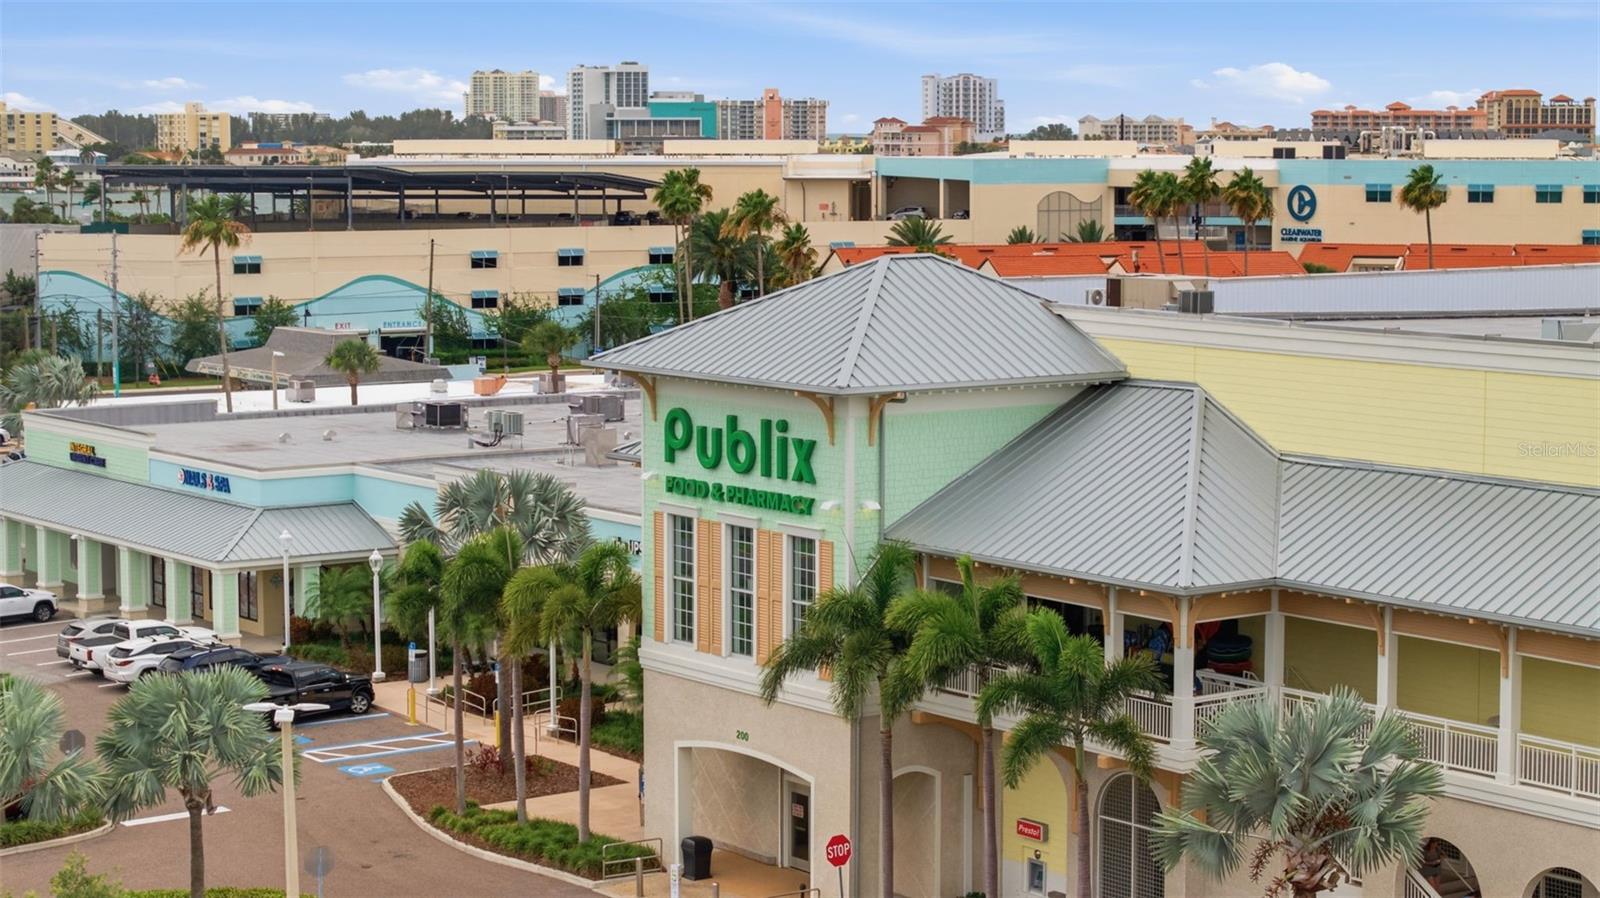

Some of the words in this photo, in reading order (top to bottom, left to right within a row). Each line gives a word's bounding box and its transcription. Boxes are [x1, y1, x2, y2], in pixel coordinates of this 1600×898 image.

[1280, 227, 1322, 237] CLEARWATER
[664, 407, 817, 484] Publix
[214, 474, 232, 494] SPA
[665, 475, 710, 499] FOOD
[710, 482, 725, 503] &
[726, 485, 816, 516] PHARMACY
[736, 729, 750, 742] 200
[827, 842, 850, 859] STOP
